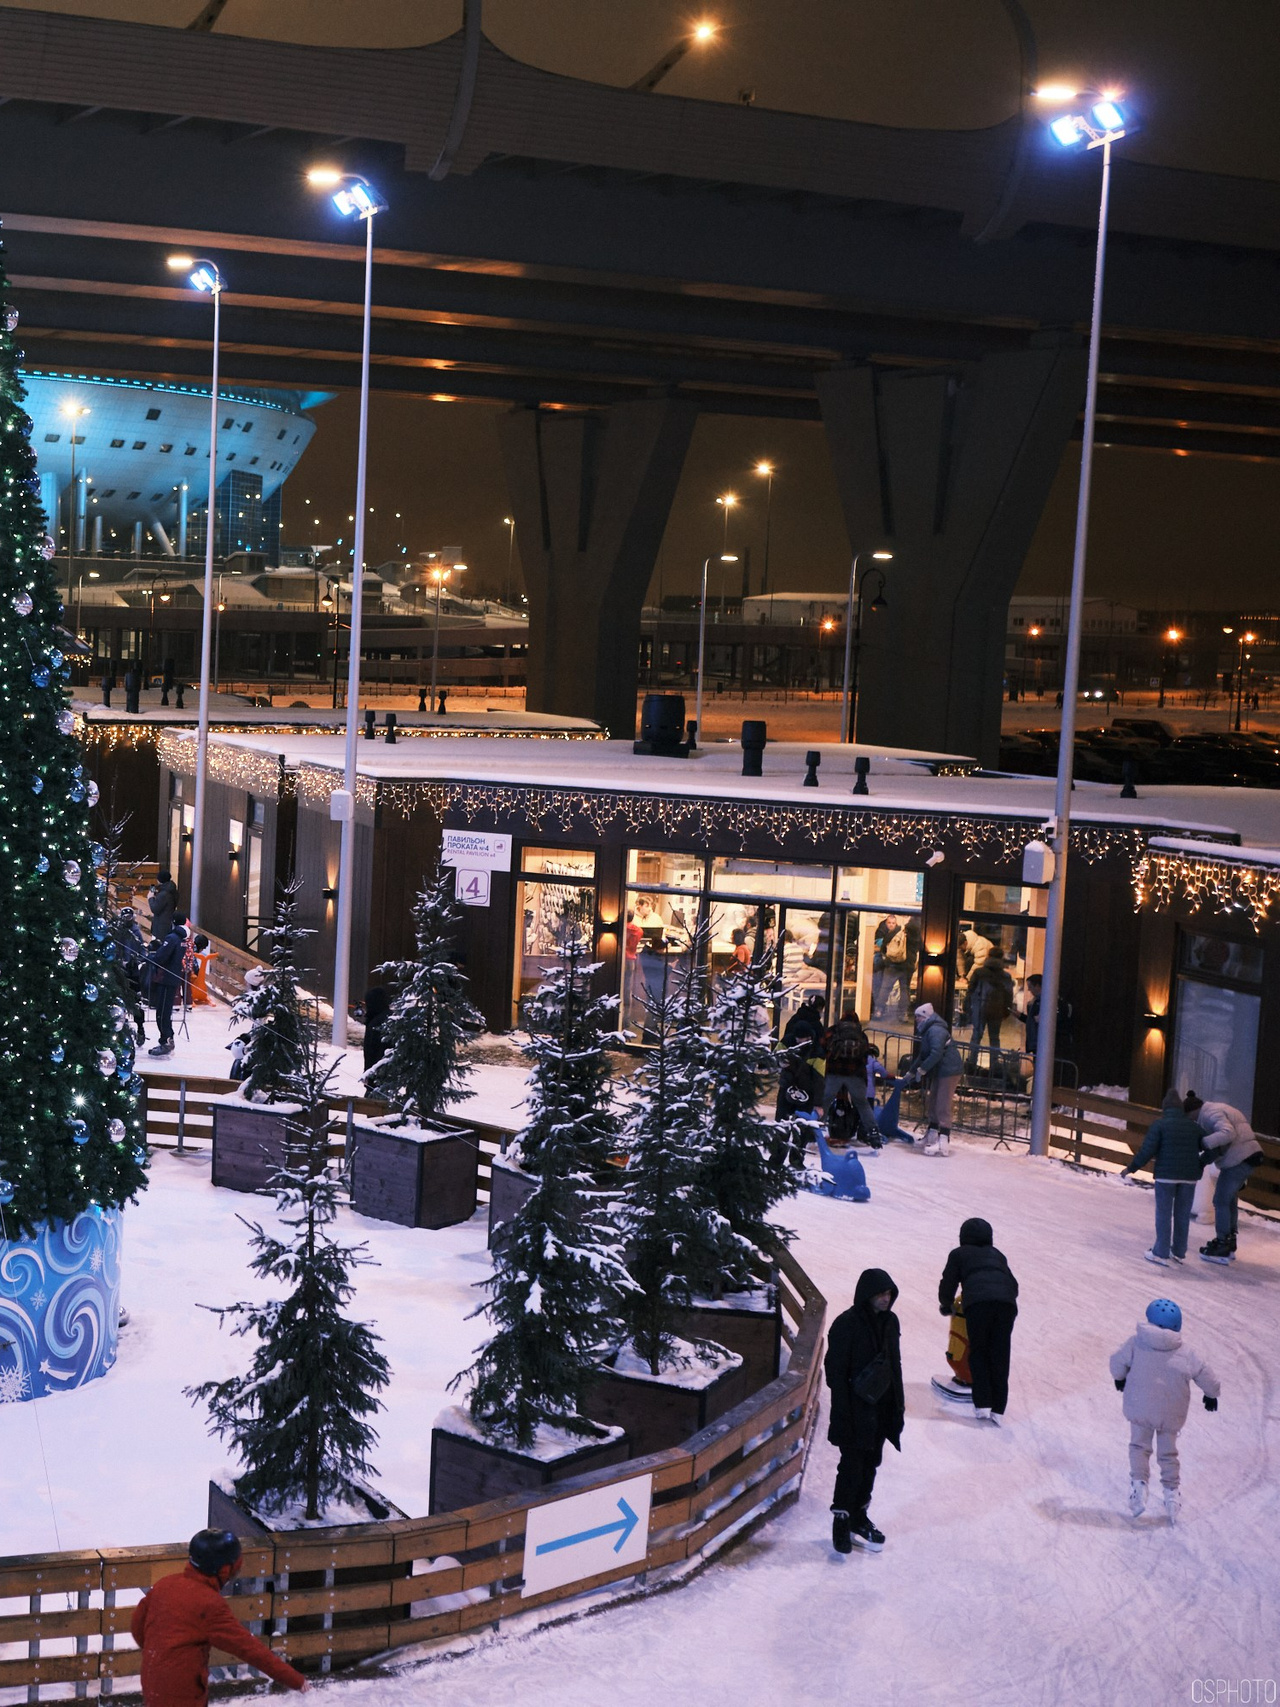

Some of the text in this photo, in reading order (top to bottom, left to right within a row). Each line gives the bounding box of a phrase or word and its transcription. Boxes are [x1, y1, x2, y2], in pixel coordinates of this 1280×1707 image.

[448, 836, 485, 844] ПАВИЛЬОН
[448, 842, 478, 850] ПРОКАТА
[466, 877, 480, 896] 4
